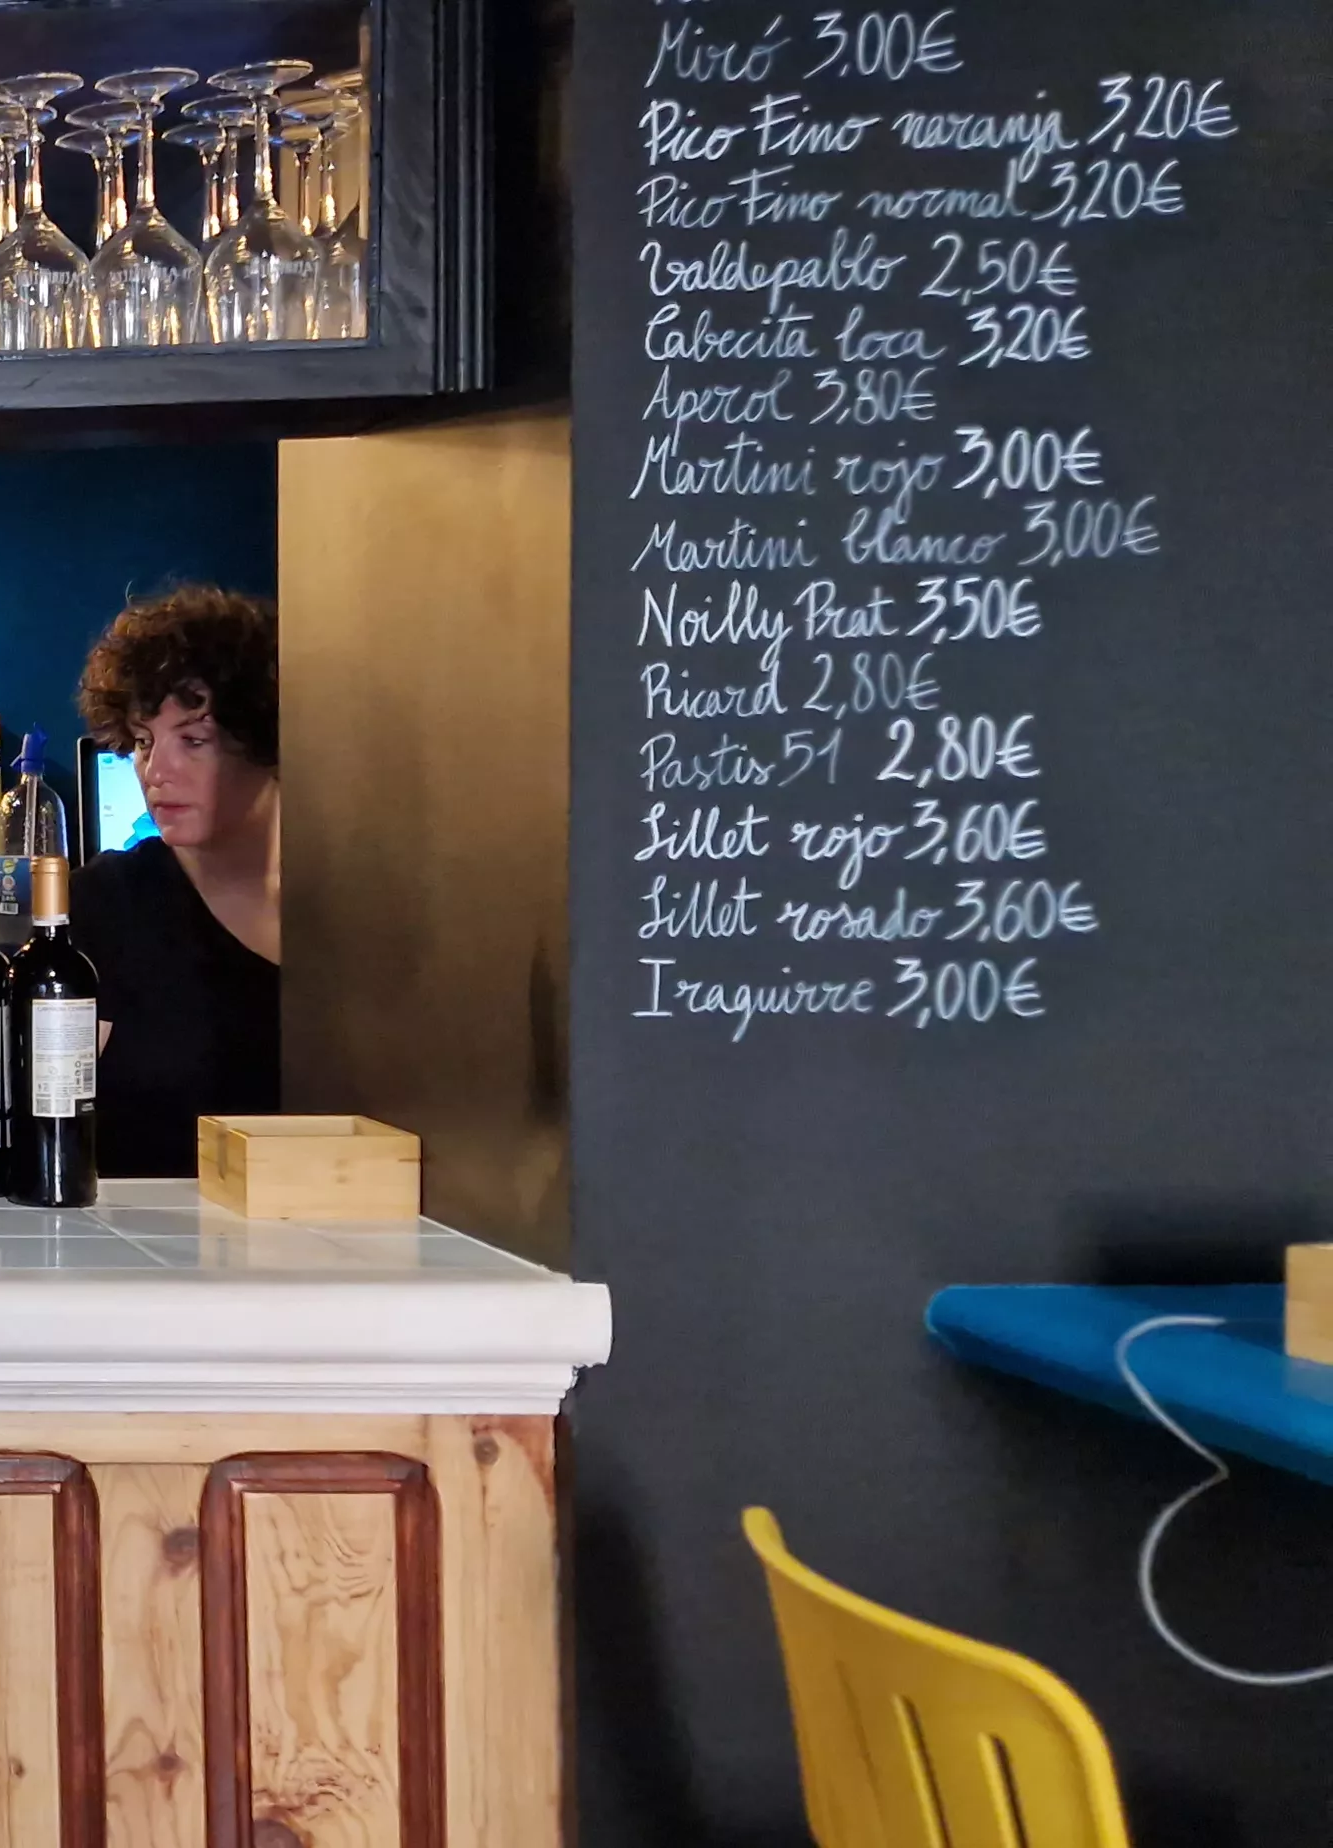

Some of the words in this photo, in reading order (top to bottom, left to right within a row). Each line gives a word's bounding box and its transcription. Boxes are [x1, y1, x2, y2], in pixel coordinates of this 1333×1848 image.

[645, 16, 790, 88] Miró
[803, 9, 965, 81] 3,00€
[639, 98, 744, 166] Pico
[750, 94, 881, 158] Fino
[892, 92, 1079, 183] naranja
[1086, 72, 1240, 154] 3,20€
[635, 173, 742, 229] Pico
[728, 165, 843, 226] Fino
[858, 158, 1026, 221] normal
[1033, 159, 1187, 227] 3,20€
[639, 228, 908, 309] Valdepablo
[920, 232, 1079, 305] 2,50€
[645, 303, 820, 363] Cabecita
[958, 305, 1092, 368] 3,20€
[642, 365, 793, 452] Aperol
[809, 367, 937, 425] 3,80€
[630, 430, 818, 499] Martini
[835, 441, 943, 523] rojo
[952, 425, 1105, 498] 3,00€
[630, 517, 818, 571] Martini
[841, 507, 1006, 566] blanco
[1018, 495, 1161, 567] 3,00€
[636, 578, 795, 672] Noilly
[792, 579, 900, 640] Prat
[906, 576, 1042, 645] 3,50€
[640, 661, 788, 720] Ricard
[802, 652, 941, 720] 2,80€
[638, 732, 777, 791] Pastis
[777, 727, 844, 789] 51
[877, 714, 1042, 789] 2,80€
[635, 802, 770, 862] Lillet
[789, 813, 905, 890] rojo
[903, 800, 1047, 865] 3,60€
[637, 875, 762, 940] Lillet
[776, 886, 942, 942] rosado
[944, 879, 1099, 943] 3,60€
[886, 958, 1046, 1029] 3,00€
